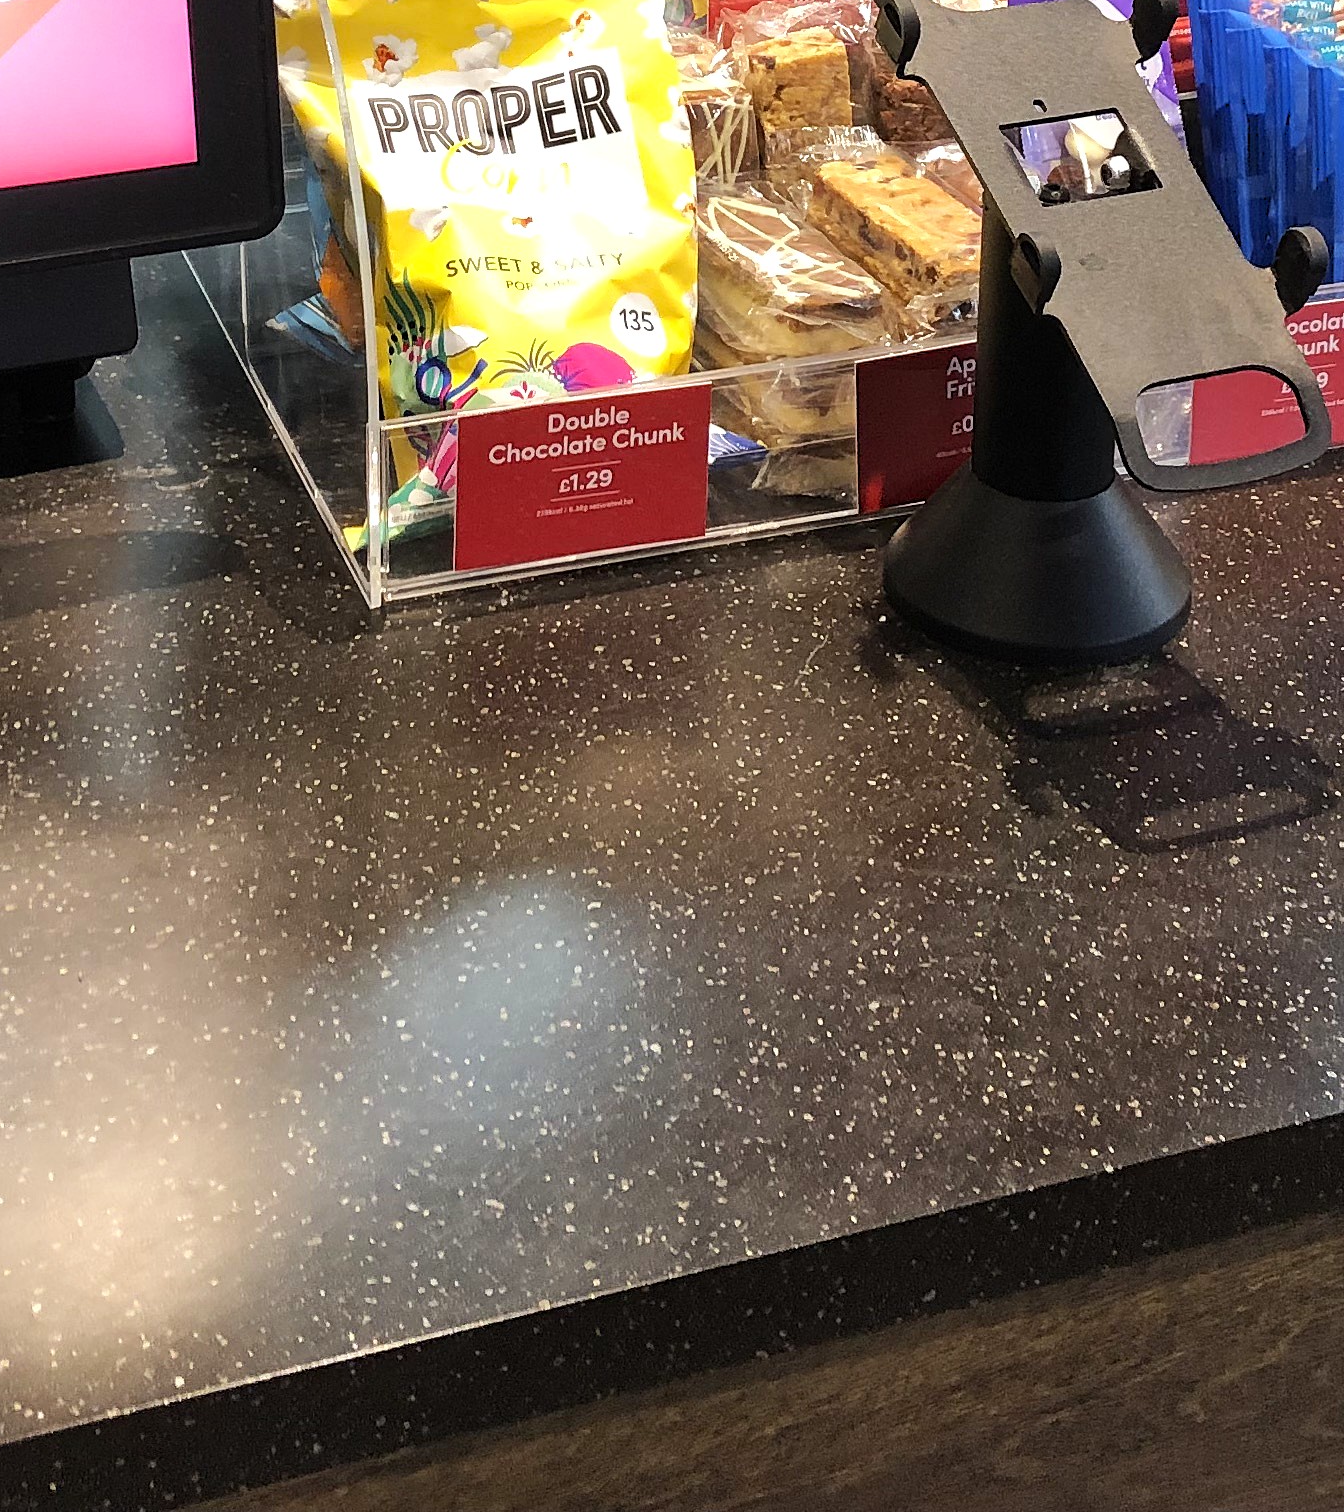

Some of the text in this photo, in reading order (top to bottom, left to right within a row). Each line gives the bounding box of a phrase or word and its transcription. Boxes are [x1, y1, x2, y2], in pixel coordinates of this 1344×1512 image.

[1308, 0, 1332, 13] WITH
[367, 64, 623, 156] PROPER
[446, 255, 522, 278] SWEET
[530, 261, 545, 275] &
[618, 308, 656, 333] 135
[946, 356, 977, 379] Ap
[547, 405, 630, 434] Double
[951, 414, 974, 436] £0
[488, 421, 686, 466] Chocolate Chunk
[557, 468, 614, 495] £1.29
